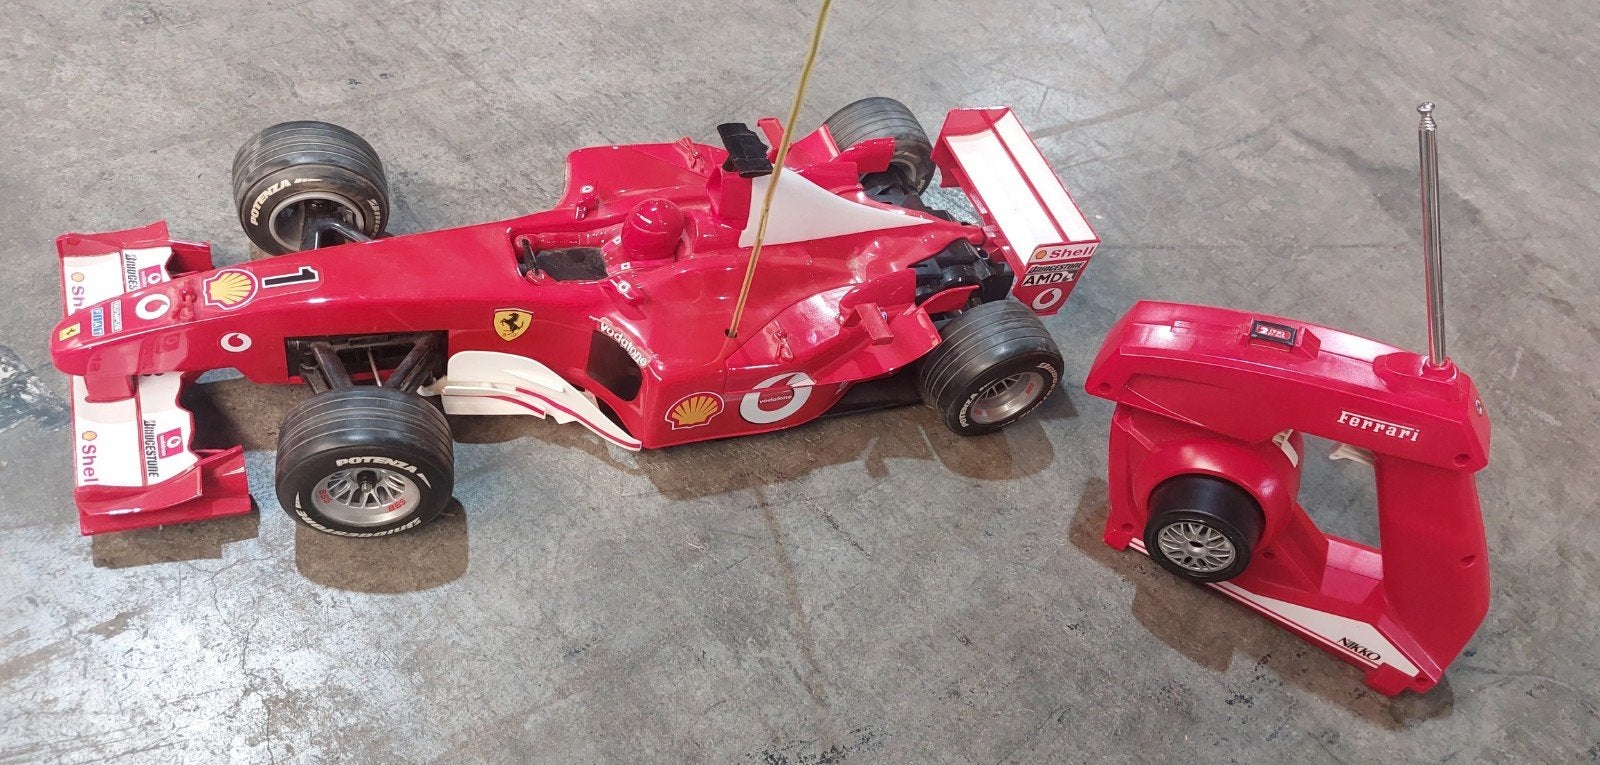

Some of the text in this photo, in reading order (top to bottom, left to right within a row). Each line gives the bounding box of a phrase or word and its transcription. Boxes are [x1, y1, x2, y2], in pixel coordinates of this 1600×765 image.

[251, 179, 292, 226] POTENZA
[1049, 246, 1095, 259] Shell
[262, 266, 319, 289] 1
[1023, 273, 1062, 286] AMD
[93, 308, 103, 335] FIAT
[600, 320, 648, 368] vodafone
[760, 394, 793, 404] vodafone
[1337, 410, 1421, 442] Ferrari
[143, 419, 160, 477] BRIDGESTONE
[335, 456, 418, 474] POTENZA
[1337, 637, 1381, 661] NIKKO
